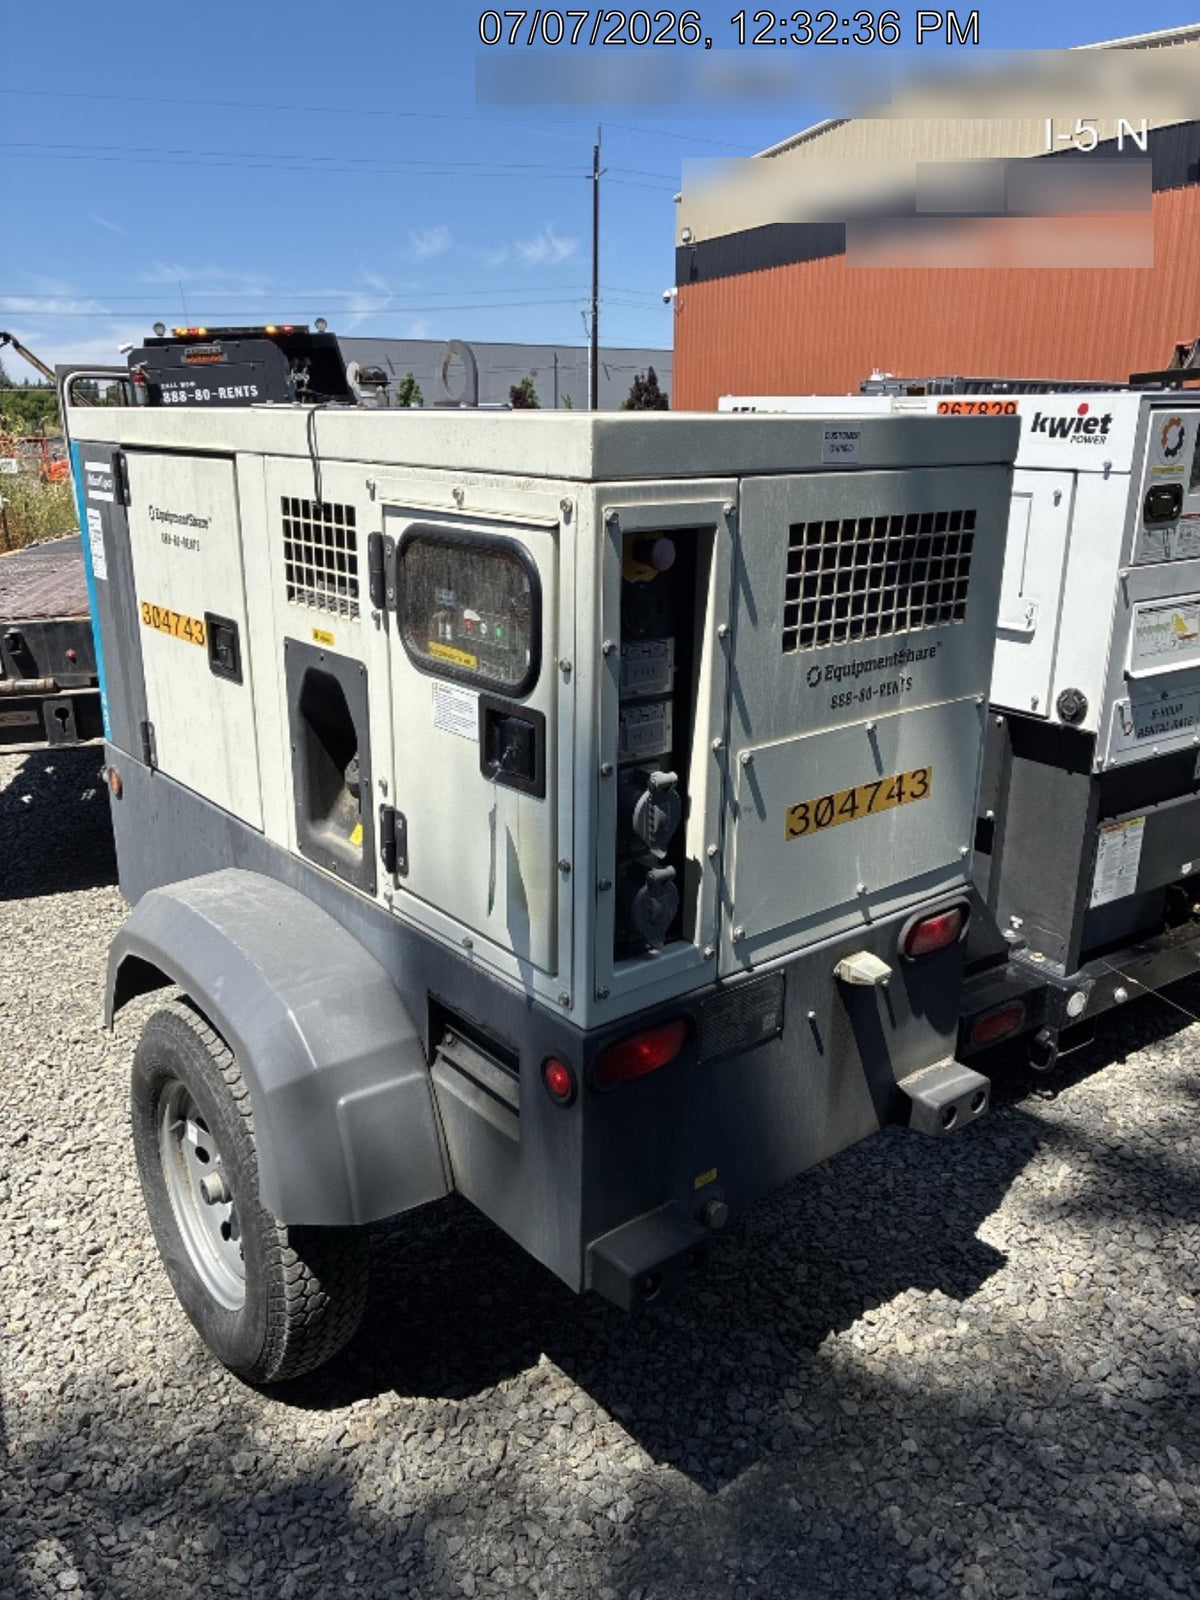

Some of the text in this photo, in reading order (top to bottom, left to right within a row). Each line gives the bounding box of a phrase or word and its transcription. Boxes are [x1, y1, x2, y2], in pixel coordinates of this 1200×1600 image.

[162, 384, 259, 404] 888-80-RENTS
[1031, 402, 1112, 438] kwiet
[1069, 435, 1107, 446] POWER
[142, 602, 206, 646] 304743
[830, 676, 913, 710] 888-80-RENTS
[789, 768, 931, 836] 304743
